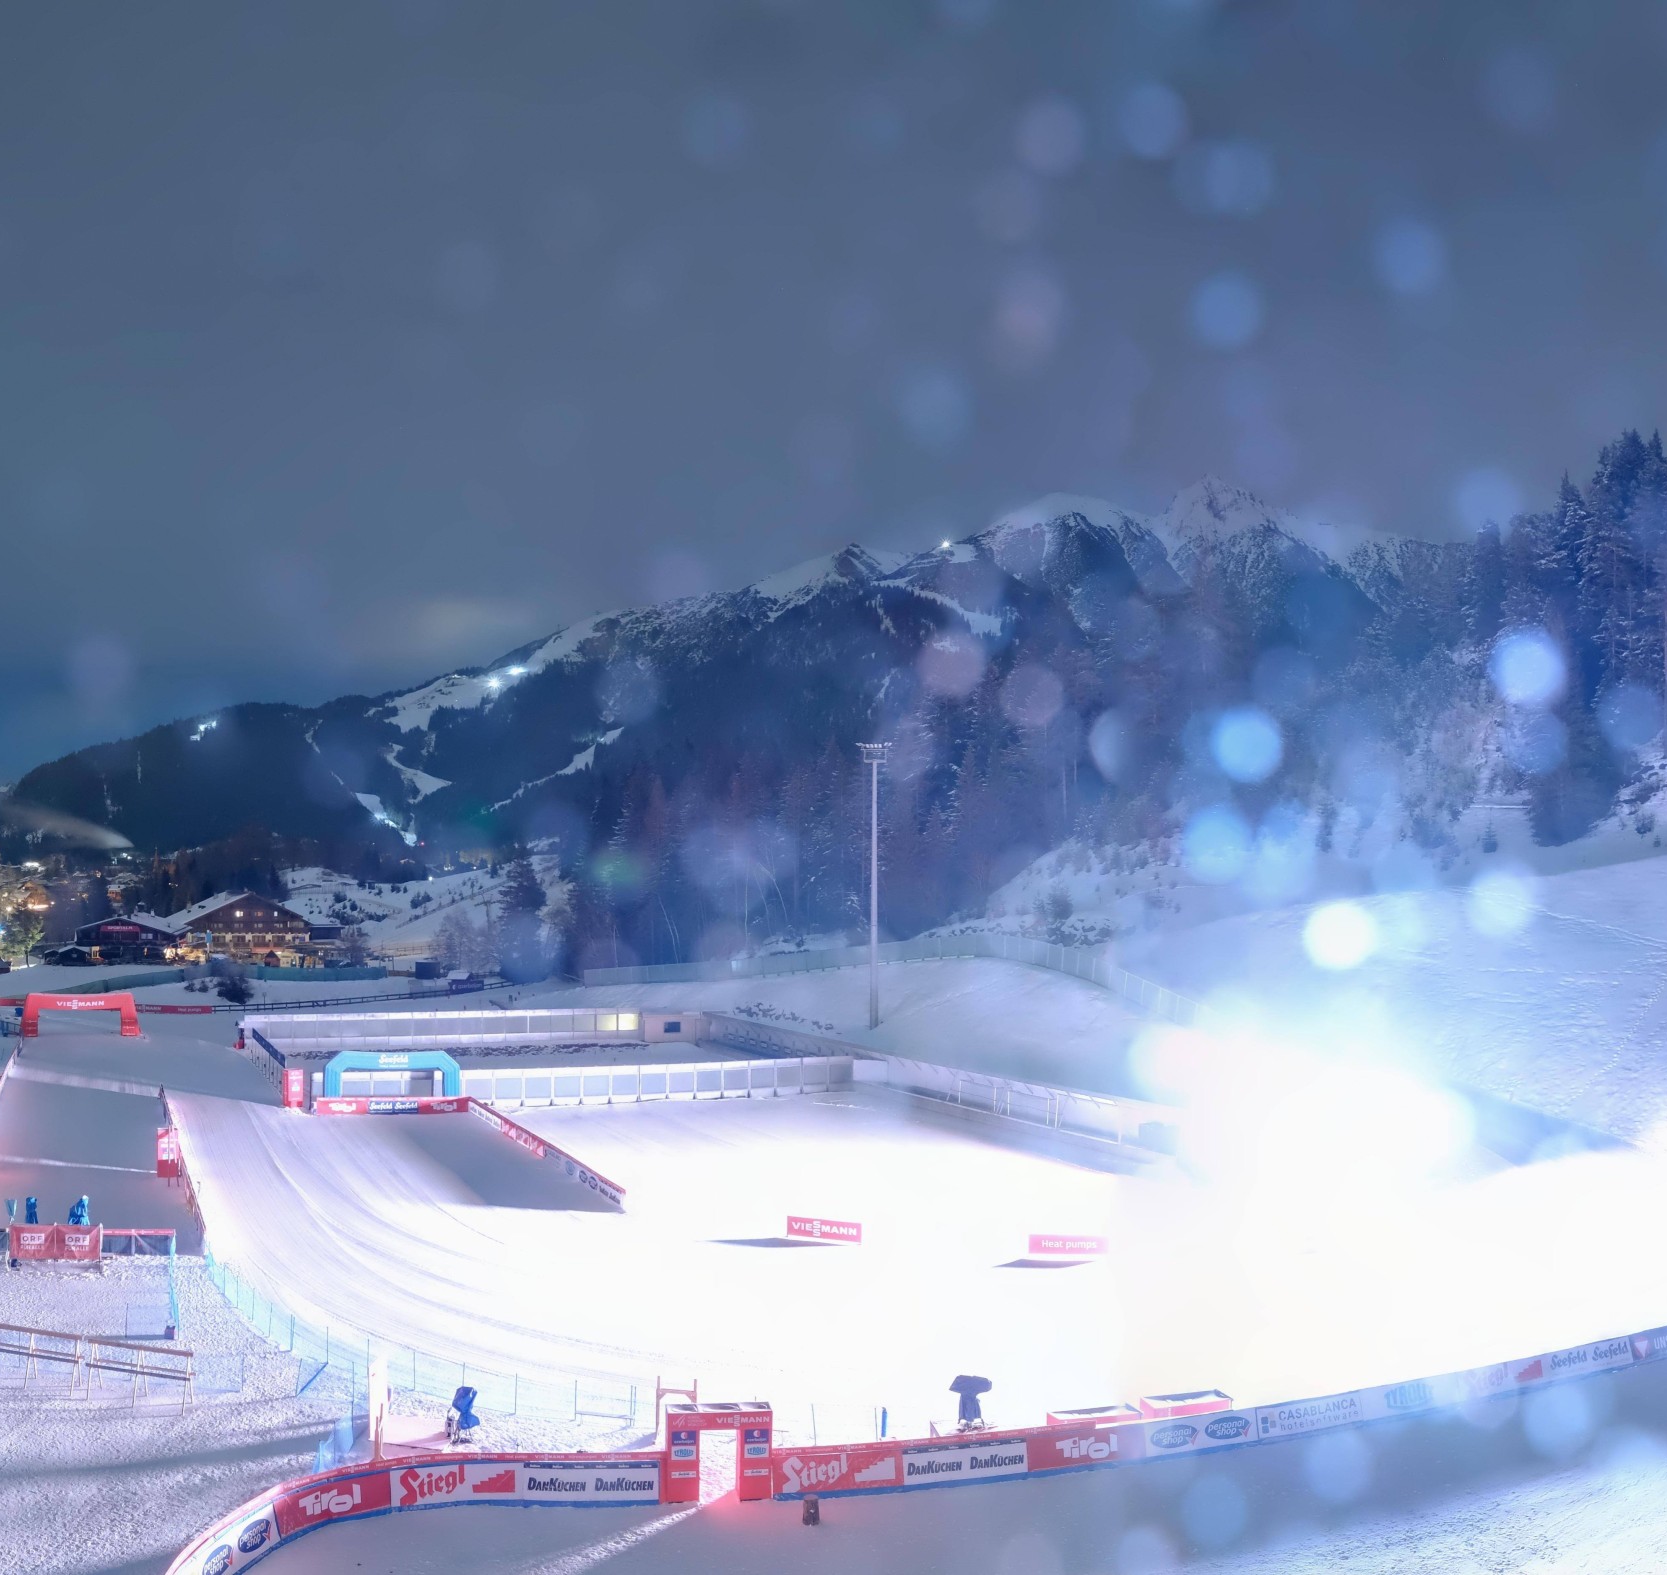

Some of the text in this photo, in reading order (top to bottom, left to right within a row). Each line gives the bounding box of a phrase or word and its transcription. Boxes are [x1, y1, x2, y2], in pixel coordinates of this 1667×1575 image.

[56, 999, 105, 1010] VIESSMANN
[379, 1053, 408, 1064] Seefeld
[369, 1101, 393, 1110] Seefeld
[791, 1220, 857, 1237] VIESSMANN
[22, 1235, 43, 1243] ORF
[67, 1236, 89, 1244] ORF
[1041, 1239, 1097, 1251] Heat pumps
[1550, 1341, 1629, 1370] Seefeld Seefeld
[1278, 1398, 1357, 1421] CASABLANCA
[716, 1414, 770, 1427] VIESSMANN
[1207, 1419, 1246, 1433] personal
[1153, 1428, 1192, 1441] personal
[1216, 1427, 1237, 1437] shop
[1055, 1433, 1118, 1459] Tirol
[1162, 1436, 1184, 1446] shop
[782, 1452, 848, 1493] Stiegl
[399, 1464, 466, 1505] Stiegl
[299, 1484, 361, 1516] Tirol
[239, 1519, 267, 1546] personal
[246, 1534, 261, 1551] shop
[204, 1546, 229, 1573] personal
